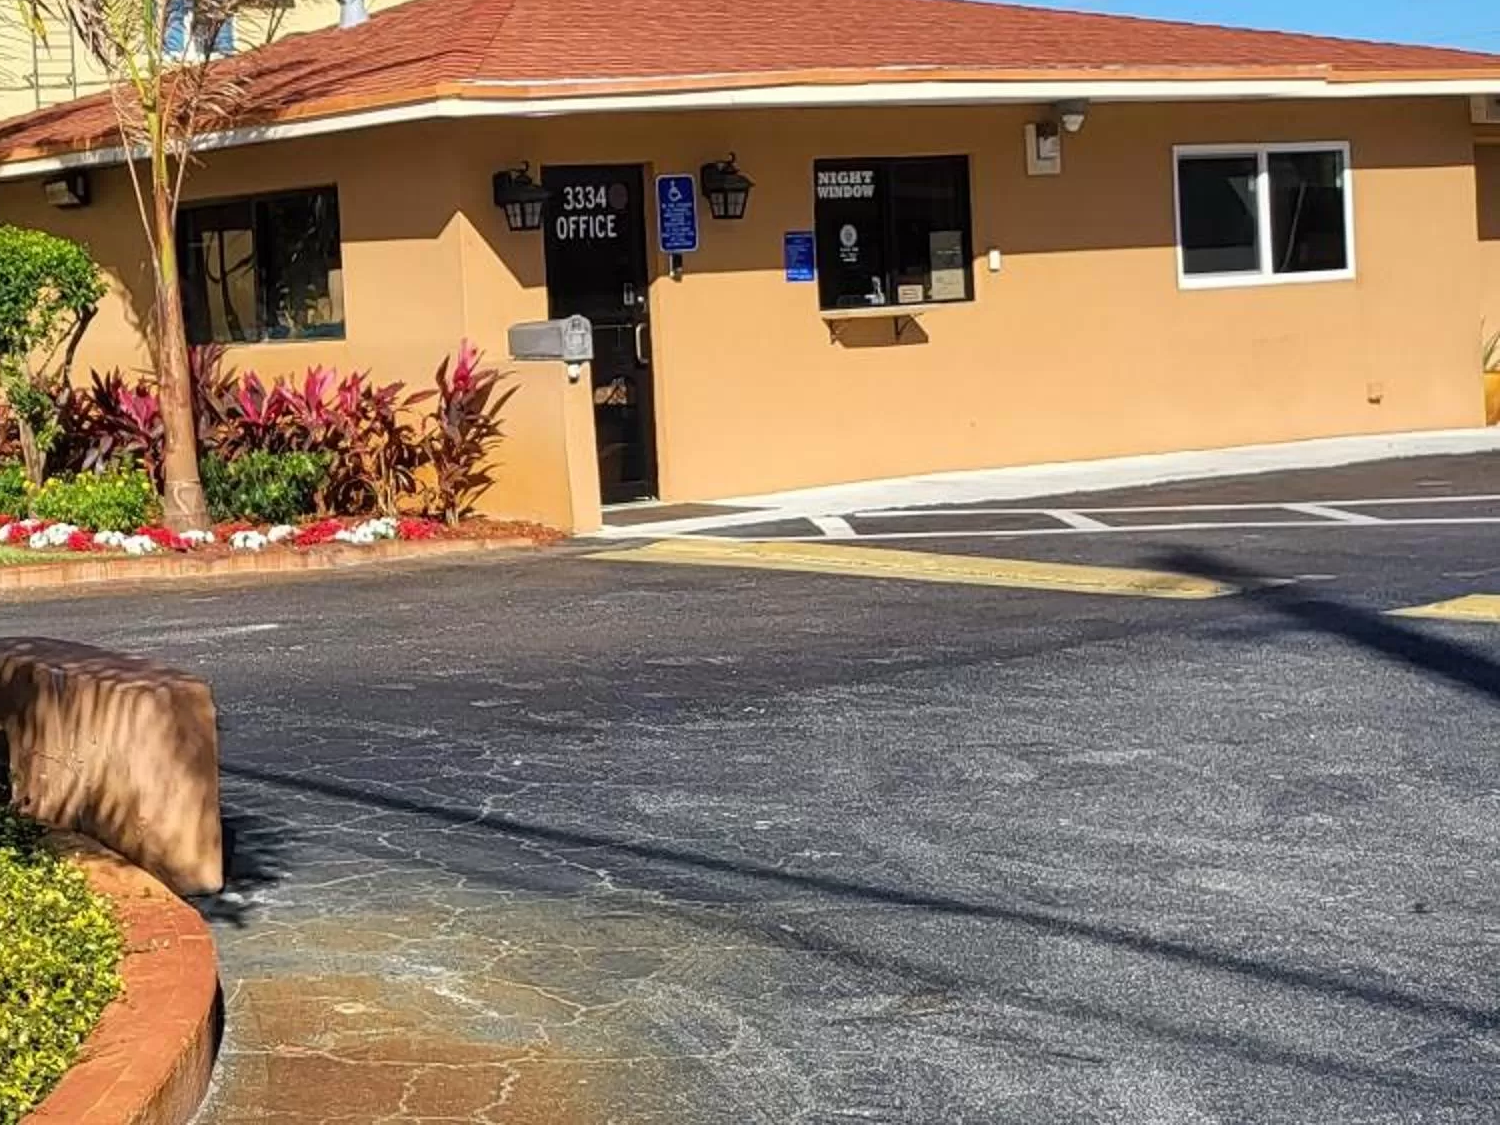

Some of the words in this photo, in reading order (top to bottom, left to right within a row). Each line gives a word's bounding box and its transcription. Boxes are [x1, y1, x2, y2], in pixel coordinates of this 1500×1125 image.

[817, 171, 873, 184] NIGHT
[563, 186, 607, 210] 3334
[817, 185, 875, 198] WINDOW
[556, 214, 617, 239] OFFICE
